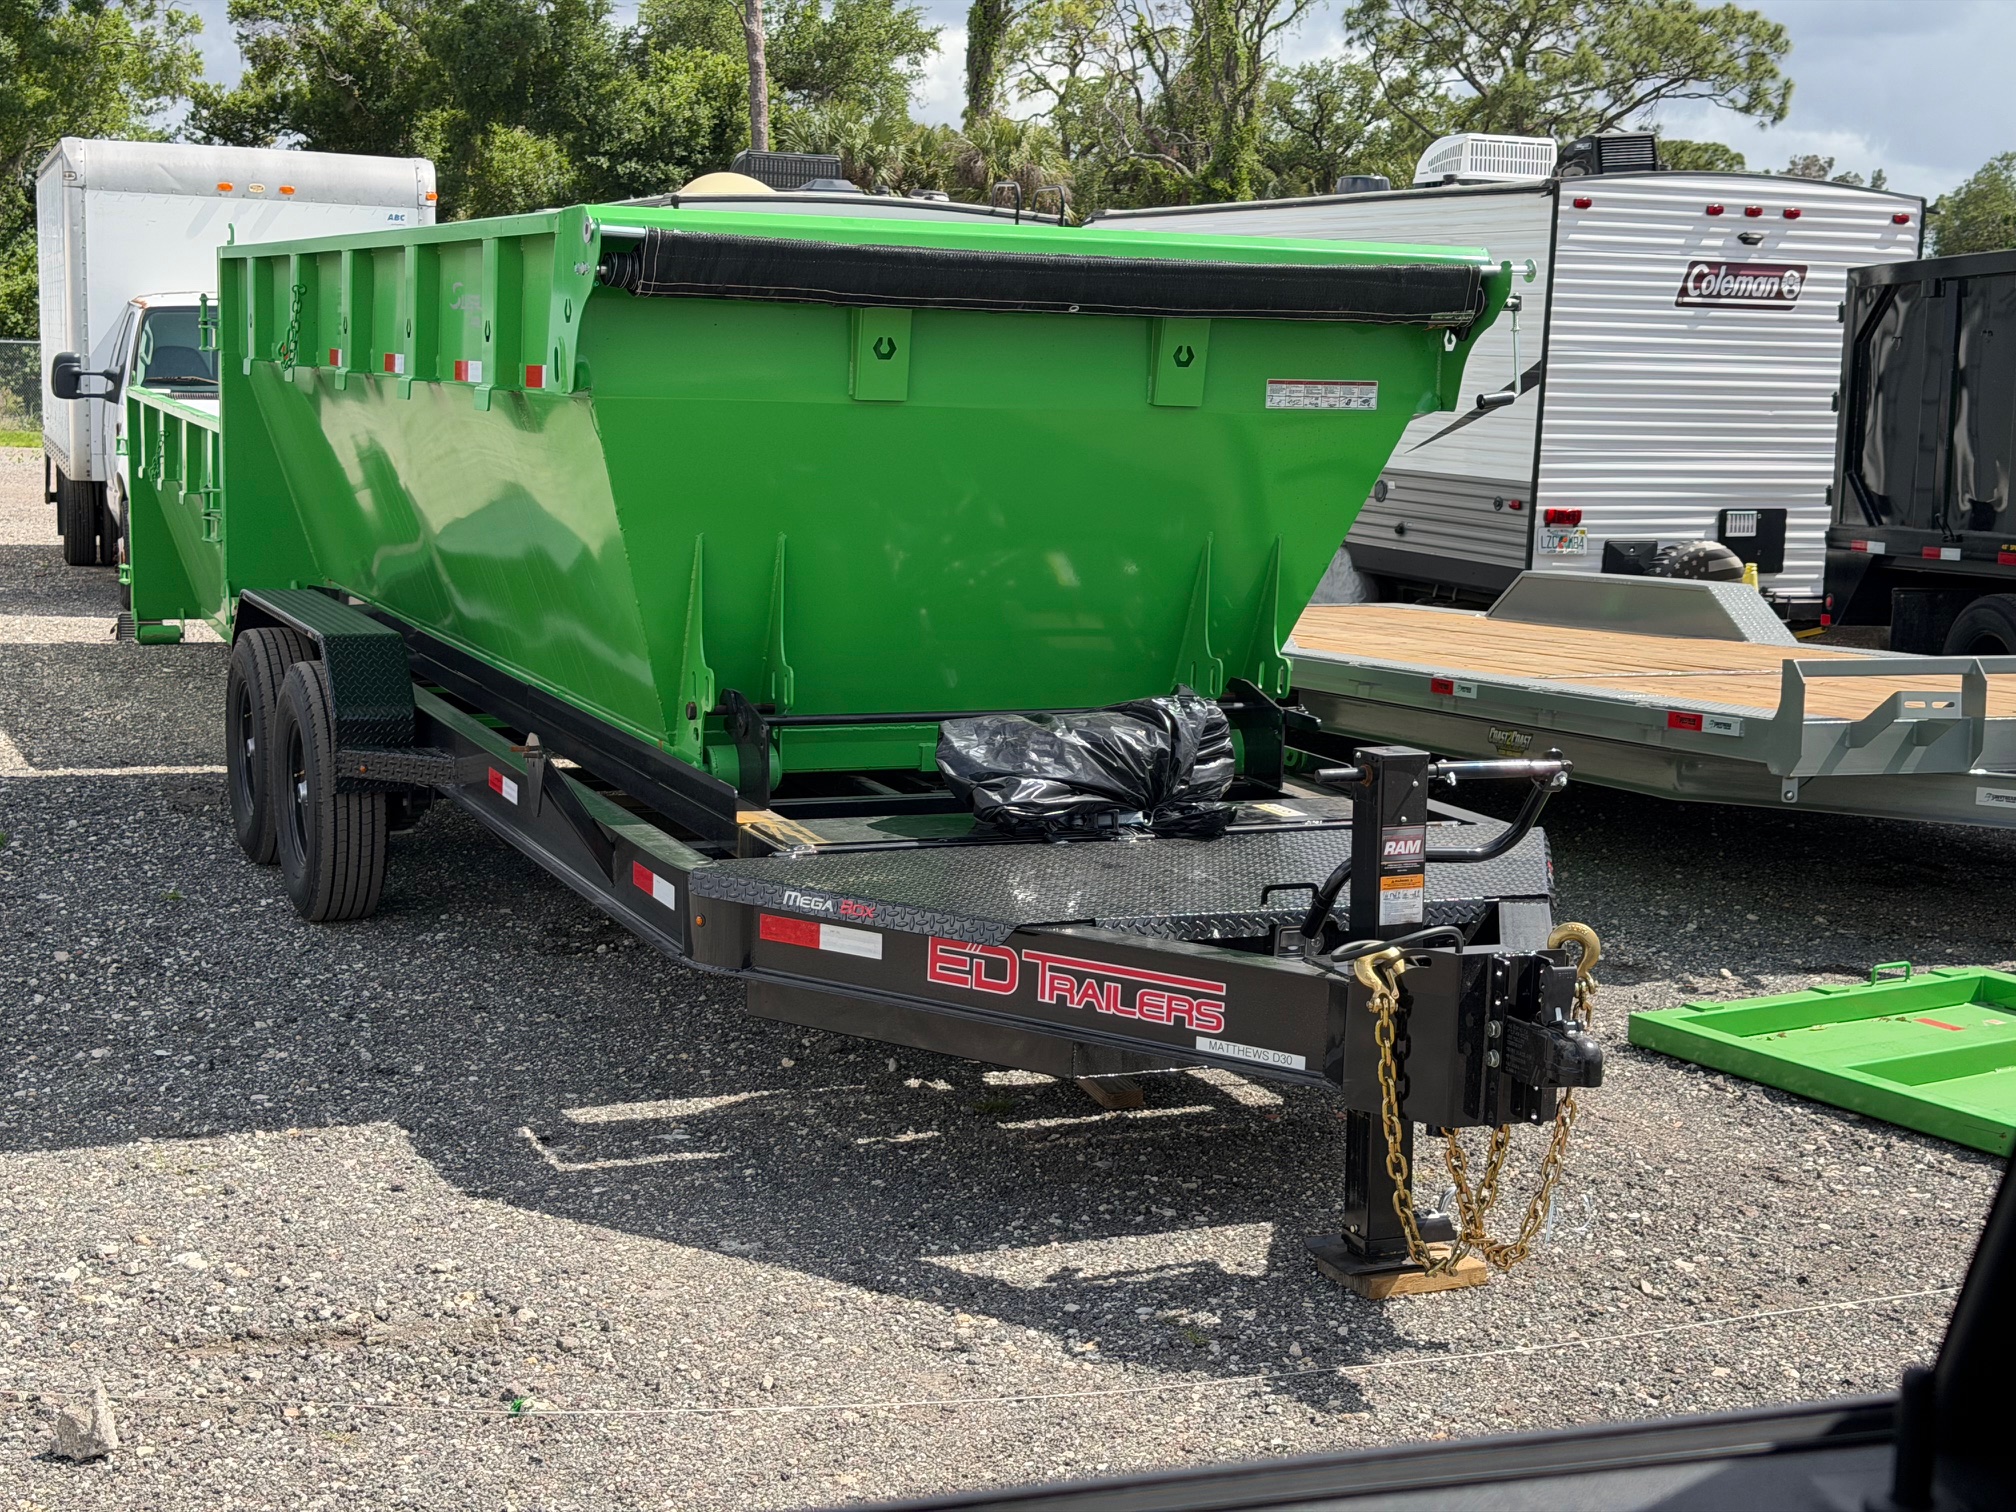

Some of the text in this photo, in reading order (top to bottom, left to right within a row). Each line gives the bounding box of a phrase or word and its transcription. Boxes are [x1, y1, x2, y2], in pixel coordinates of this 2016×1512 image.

[387, 213, 405, 222] ABC
[1687, 263, 1779, 298] Coleman
[1384, 839, 1422, 856] RAM
[783, 890, 876, 918] MEGA BOX
[927, 935, 1226, 1034] ED TRAILERS
[1208, 1040, 1293, 1066] MATTHEWS D30
